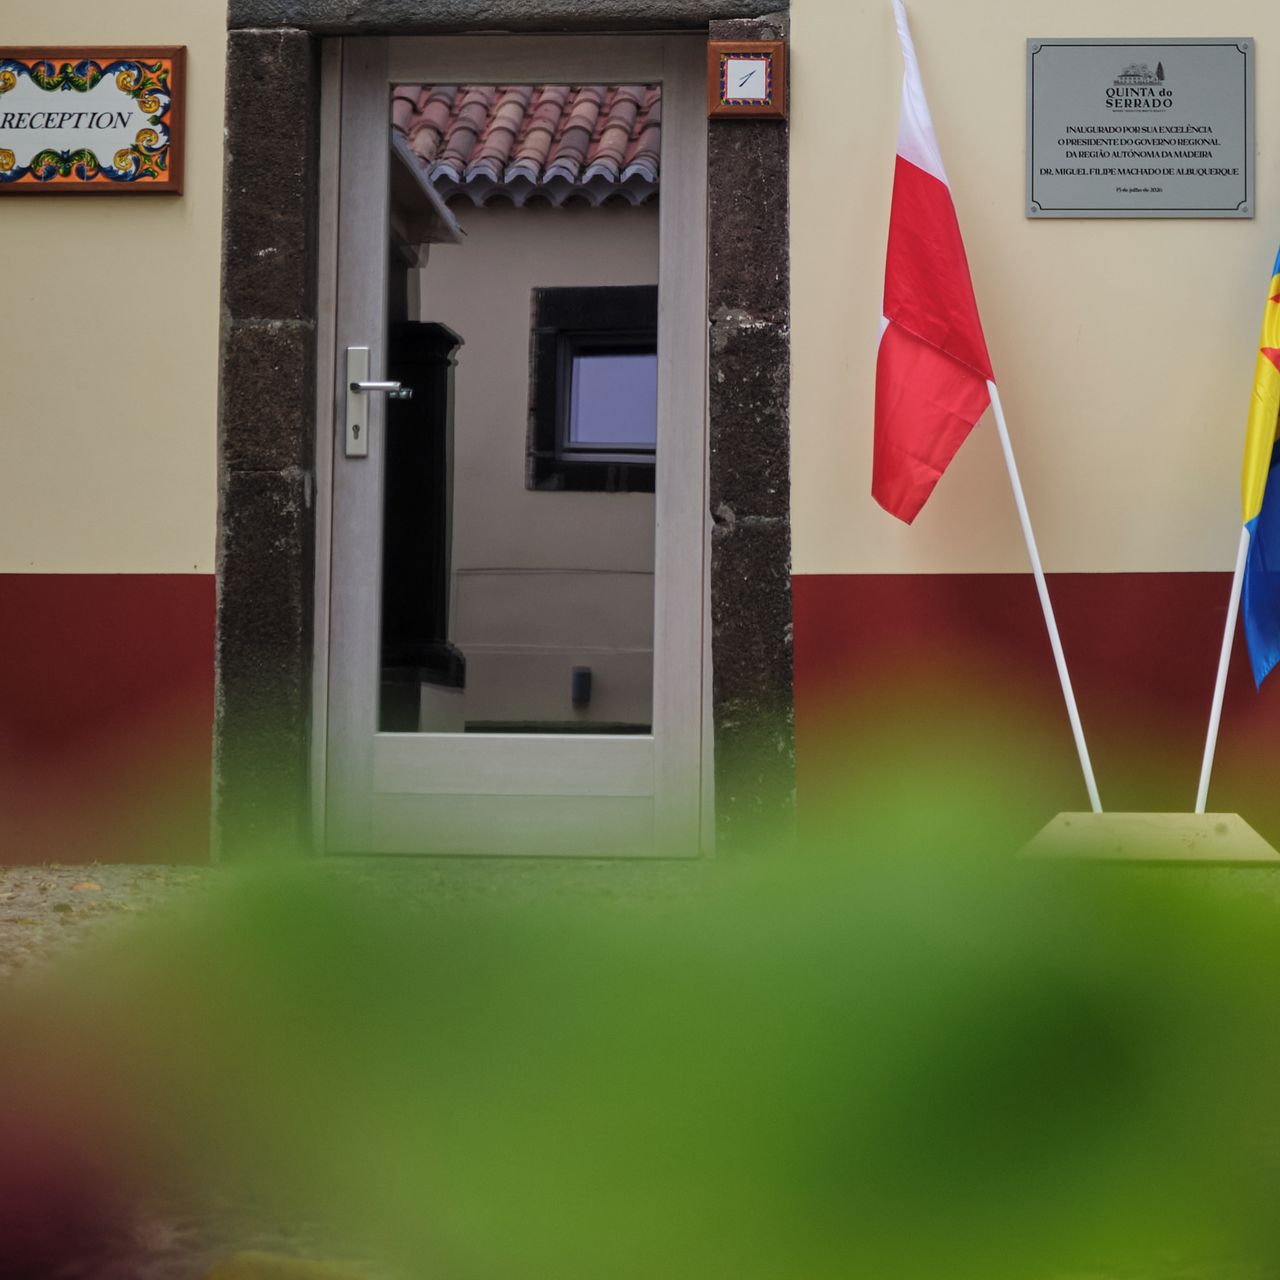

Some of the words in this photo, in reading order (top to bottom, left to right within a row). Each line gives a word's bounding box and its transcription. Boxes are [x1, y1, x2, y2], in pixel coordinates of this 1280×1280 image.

[739, 70, 756, 87] 1
[1105, 87, 1155, 98] QUINTA
[1158, 87, 1173, 97] do
[1105, 98, 1173, 108] SERRADO
[0, 111, 134, 130] RECEPTION
[1159, 123, 1213, 133] EXCELÊNCIA
[1057, 138, 1065, 146] O
[1066, 138, 1119, 146] PRESIDENTE
[1120, 138, 1133, 146] DO
[1134, 138, 1176, 146] GOVERNO
[1177, 138, 1221, 146] REGIONAL
[1078, 149, 1110, 158] REGIÃO
[1111, 149, 1159, 158] AUTÓNOMA
[1054, 168, 1088, 176] MIGUEL
[1089, 168, 1116, 176] FILIPE
[1117, 168, 1161, 176] MACHADO
[1162, 168, 1175, 176] DE
[1176, 168, 1240, 177] ALBUQUERQUE
